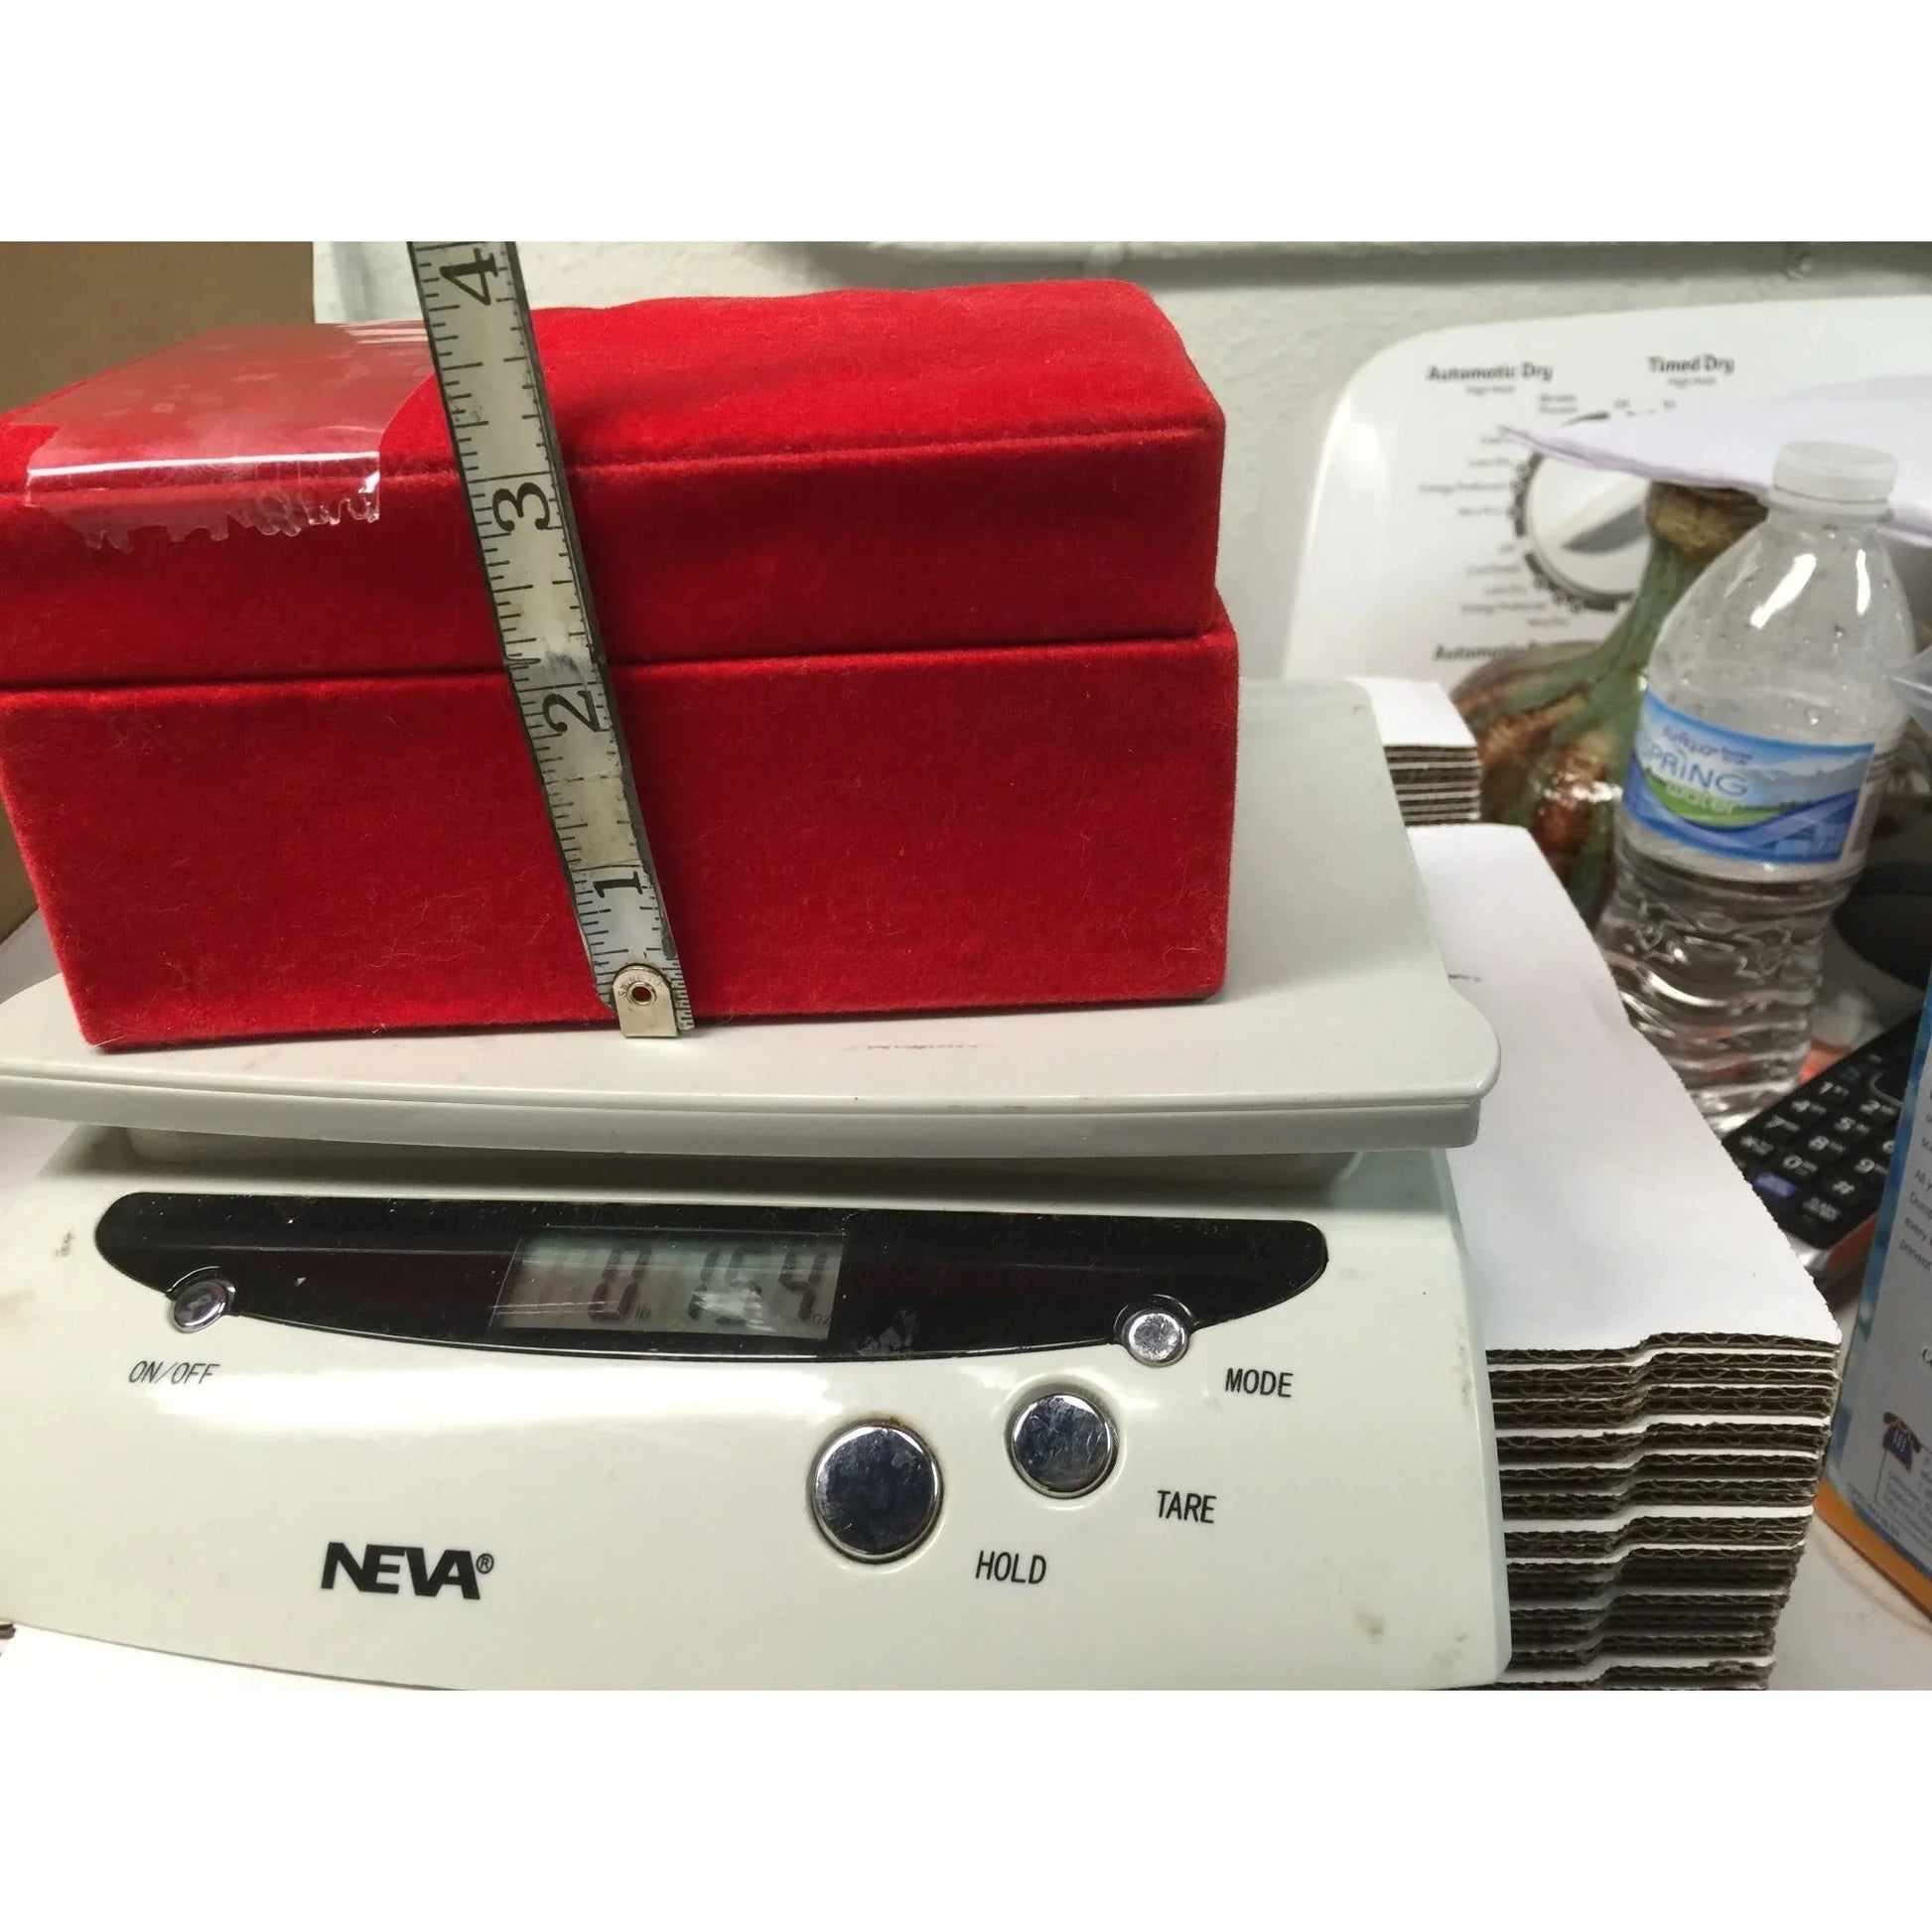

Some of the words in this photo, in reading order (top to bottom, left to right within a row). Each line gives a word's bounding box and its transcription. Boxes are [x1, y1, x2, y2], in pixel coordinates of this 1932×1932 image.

[440, 247, 499, 306] 4
[1426, 363, 1516, 382] Automatic
[1521, 360, 1554, 383] Dry
[1648, 354, 1701, 373] Timed
[1704, 352, 1735, 375] Dry
[491, 481, 551, 532] 3
[542, 689, 602, 733] 2
[594, 870, 643, 898] 1
[128, 1360, 220, 1386] ON/OFF
[1224, 1367, 1295, 1398] MODE
[1157, 1489, 1217, 1524] TARE
[975, 1550, 1048, 1585] HOLD
